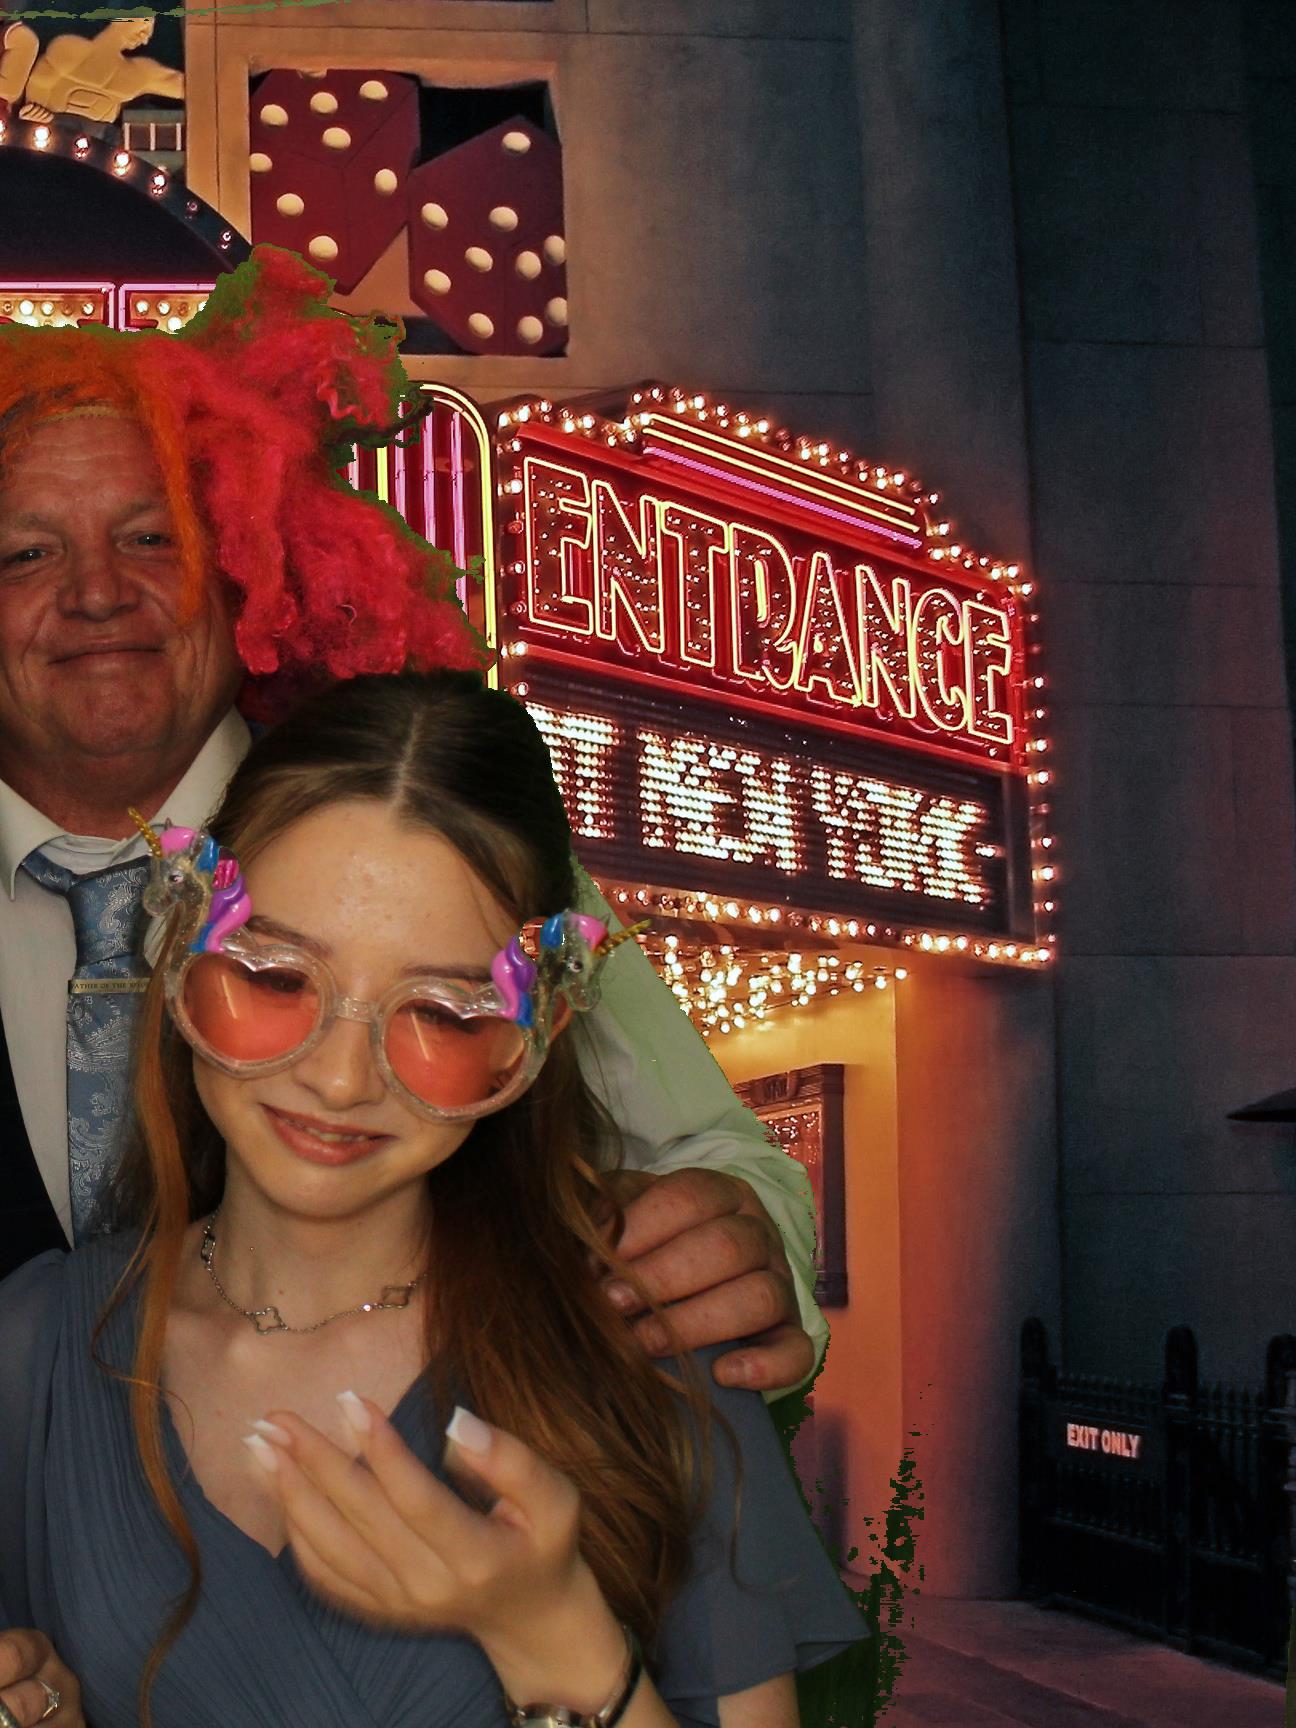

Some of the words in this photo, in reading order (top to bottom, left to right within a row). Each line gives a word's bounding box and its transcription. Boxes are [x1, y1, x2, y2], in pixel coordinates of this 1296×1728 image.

[523, 456, 1014, 744] ENTRANCE
[1067, 1423, 1098, 1450] EXIT
[1101, 1430, 1139, 1458] ONLY
